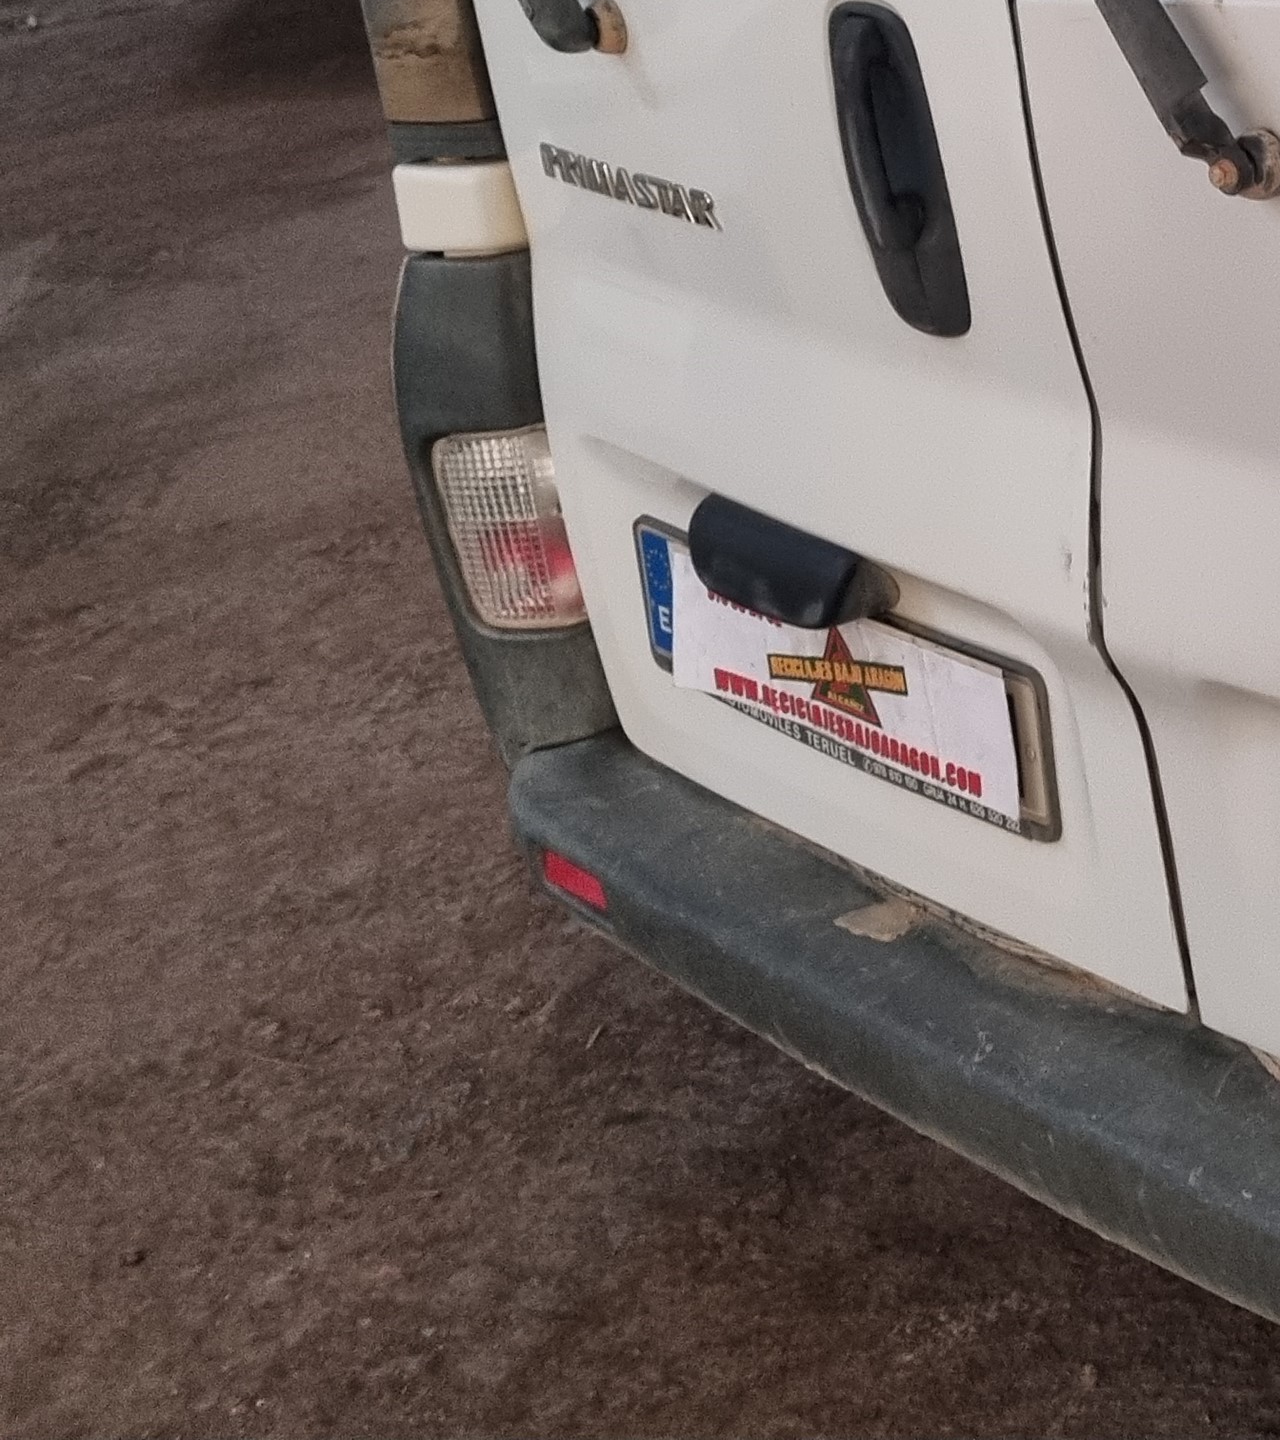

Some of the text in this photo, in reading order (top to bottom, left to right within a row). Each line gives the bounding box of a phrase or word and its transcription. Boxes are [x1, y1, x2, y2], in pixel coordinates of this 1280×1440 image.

[540, 141, 723, 232] PRIMASTAR
[658, 605, 672, 634] E
[806, 730, 855, 765] TERUEL
